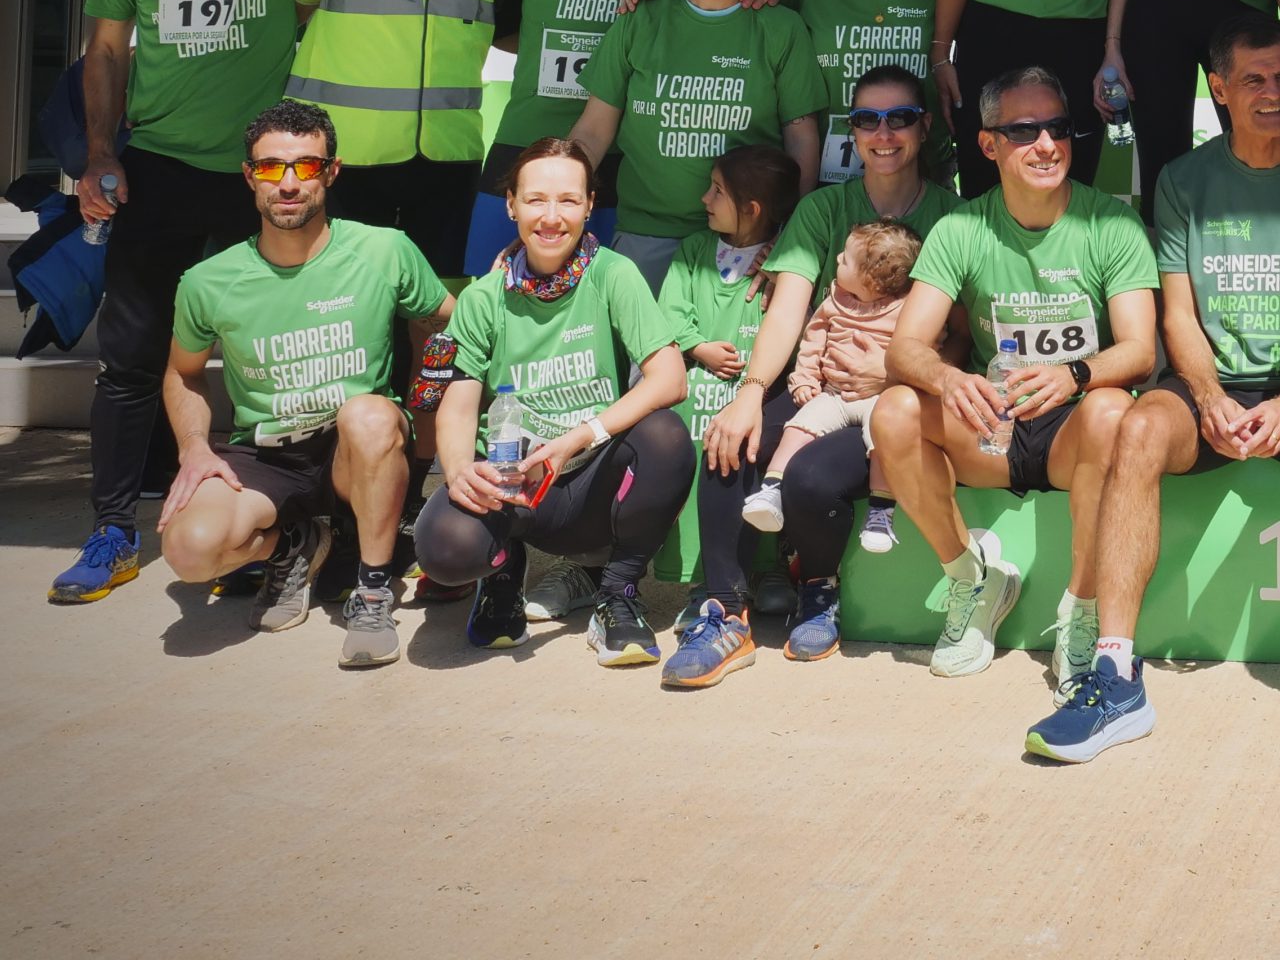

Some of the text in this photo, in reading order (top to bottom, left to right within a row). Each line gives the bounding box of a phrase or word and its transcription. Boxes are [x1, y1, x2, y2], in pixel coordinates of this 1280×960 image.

[178, 0, 234, 27] 197
[887, 6, 928, 16] Schneider
[560, 34, 601, 46] Schneid
[835, 25, 922, 50] V CARRERA
[711, 55, 751, 66] Schneider
[830, 53, 839, 67] LA
[656, 73, 744, 102] V CARRERA
[633, 100, 752, 131] POR LA SEGURIDAD
[1039, 268, 1080, 281] Schneider
[306, 295, 354, 312] Schneider
[328, 302, 355, 312] Electric
[1012, 306, 1071, 319] Schneider
[1222, 313, 1238, 330] DE
[252, 320, 353, 364] V CARRERA
[1012, 326, 1086, 356] 168
[257, 367, 267, 380] LA
[270, 347, 367, 390] SEGURIDAD
[510, 349, 596, 391] V CARRERA
[523, 377, 614, 411] SEGURIDAD
[528, 414, 570, 435] Schneid
